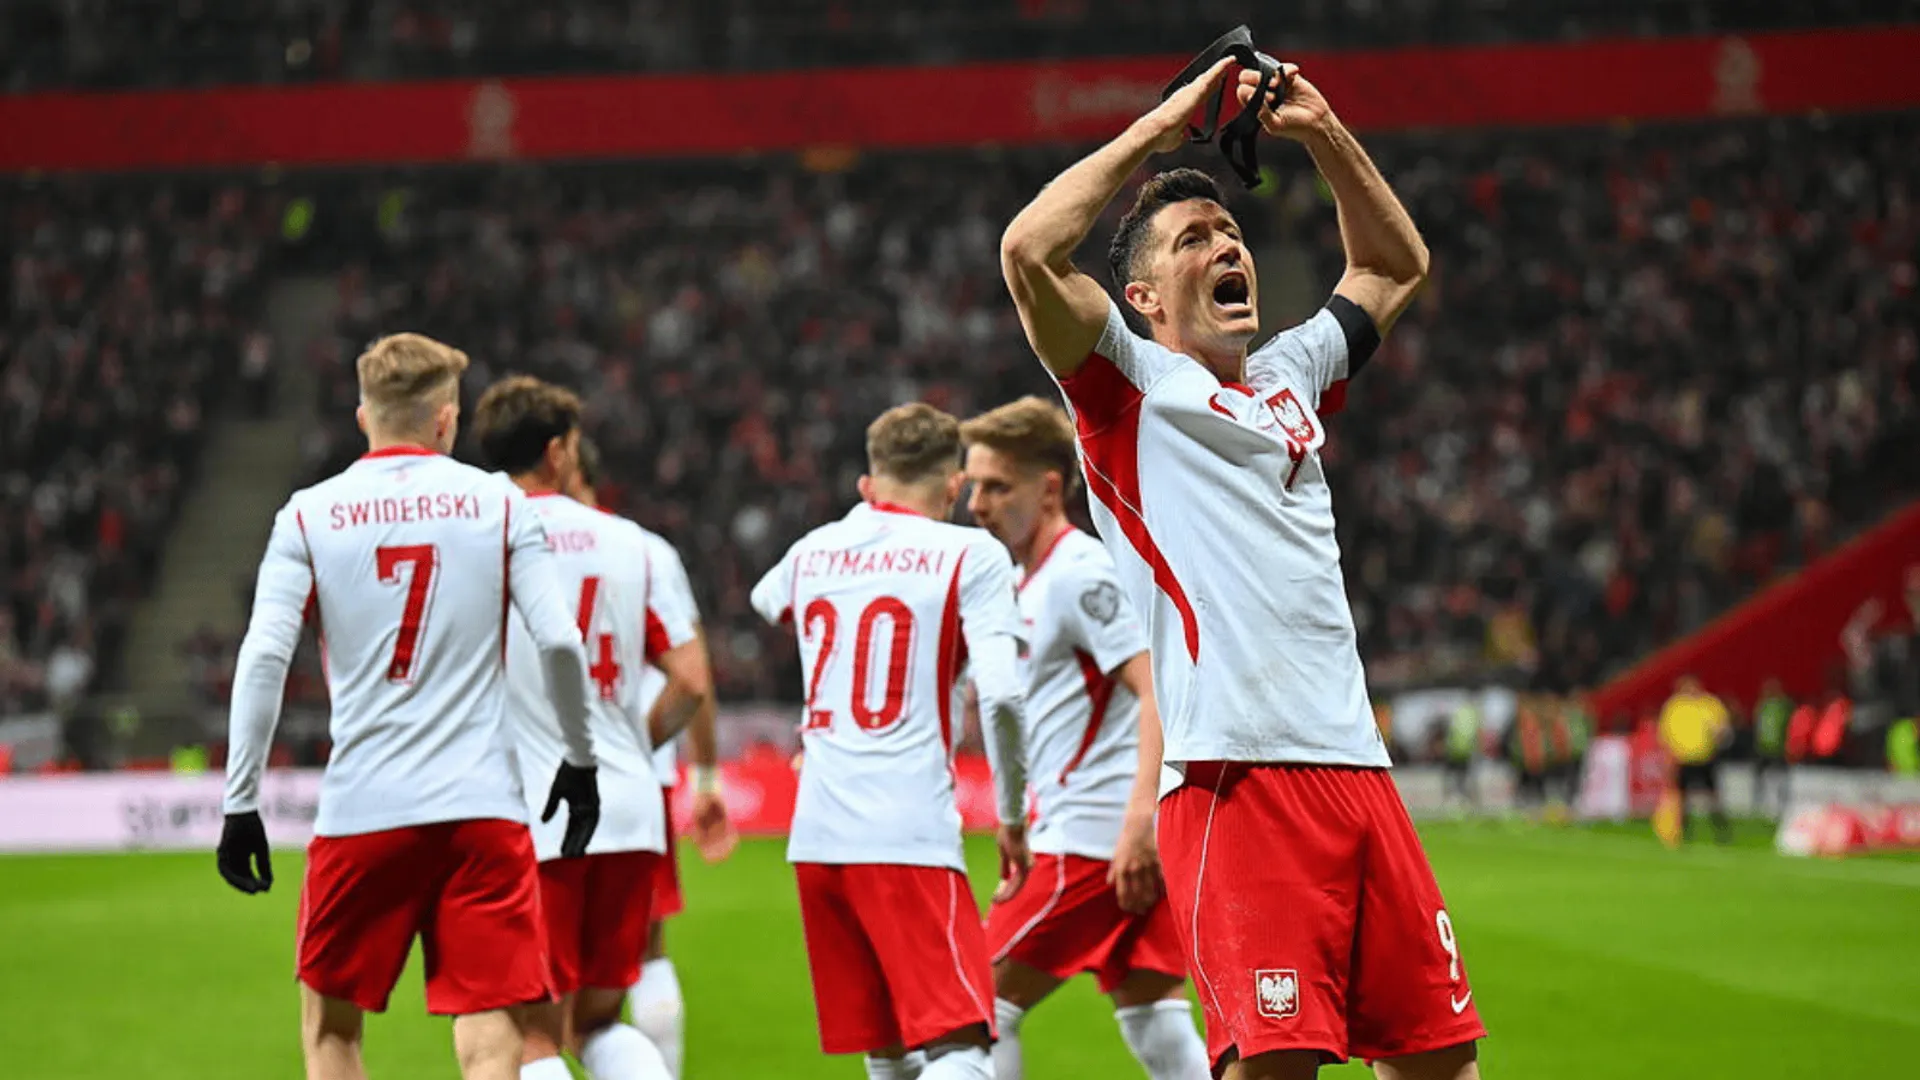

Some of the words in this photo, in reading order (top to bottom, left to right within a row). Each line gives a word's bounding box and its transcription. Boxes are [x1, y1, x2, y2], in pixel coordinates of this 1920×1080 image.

[375, 543, 439, 684] 7
[803, 594, 917, 736] 20
[1436, 909, 1460, 981] 9
